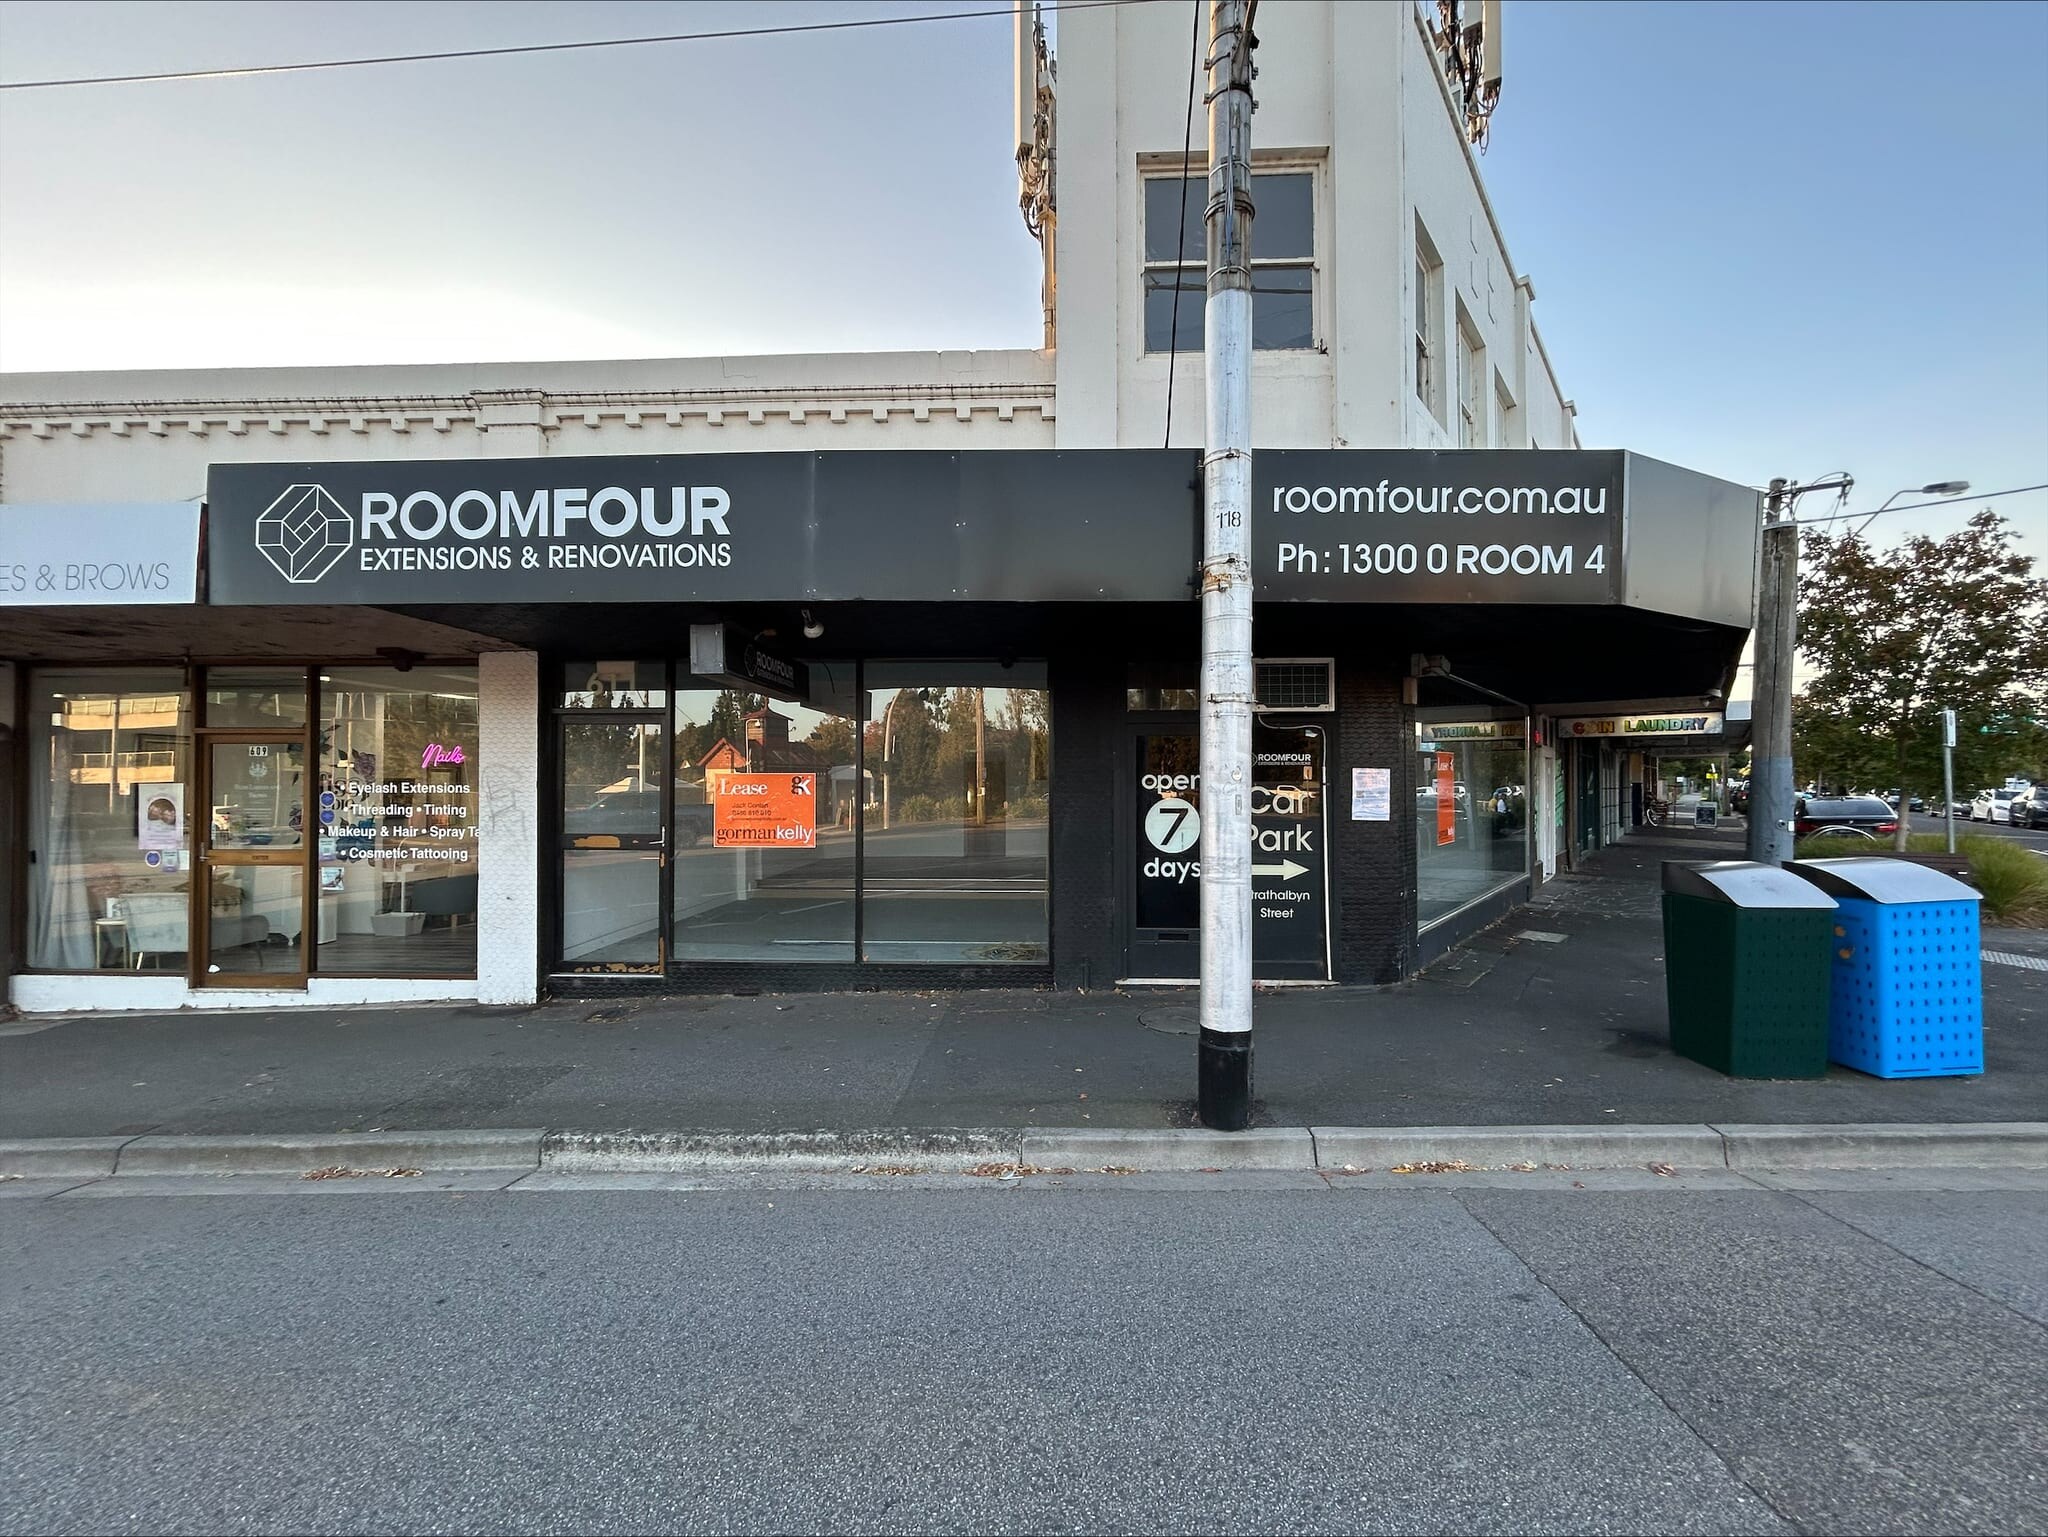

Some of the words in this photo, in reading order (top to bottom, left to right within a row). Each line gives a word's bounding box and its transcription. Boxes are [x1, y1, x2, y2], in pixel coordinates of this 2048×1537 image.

[1273, 479, 1607, 514] roomfour.com.au
[360, 486, 731, 541] ROOMFOUR
[1216, 511, 1241, 528] 118
[360, 546, 512, 571] EXTENSIONS
[520, 545, 540, 570] &
[548, 543, 732, 569] RENOVATIONS
[1338, 543, 1418, 574] 1300
[1456, 544, 1573, 575] ROOM
[1584, 544, 1606, 574] 4
[35, 564, 56, 592] &
[65, 562, 170, 591] BROWS
[1624, 717, 1709, 733] LAUNDRY
[249, 746, 268, 757] 609
[421, 743, 466, 768] Nails
[1257, 753, 1312, 762] ROOMFOUR
[349, 782, 398, 796] Eyelash
[401, 782, 470, 794] Extensions
[719, 778, 768, 796] Lease
[351, 804, 413, 818] Threading
[423, 804, 467, 818] Tinting
[328, 826, 376, 840] Makeup
[380, 826, 389, 838] &
[393, 826, 418, 838] Hair
[430, 826, 466, 840] Spray
[716, 824, 813, 844] gormankelly
[1159, 808, 1189, 846] 7
[349, 847, 408, 860] Cosmetic
[410, 847, 468, 861] Tattooing
[1260, 907, 1294, 919] Street
